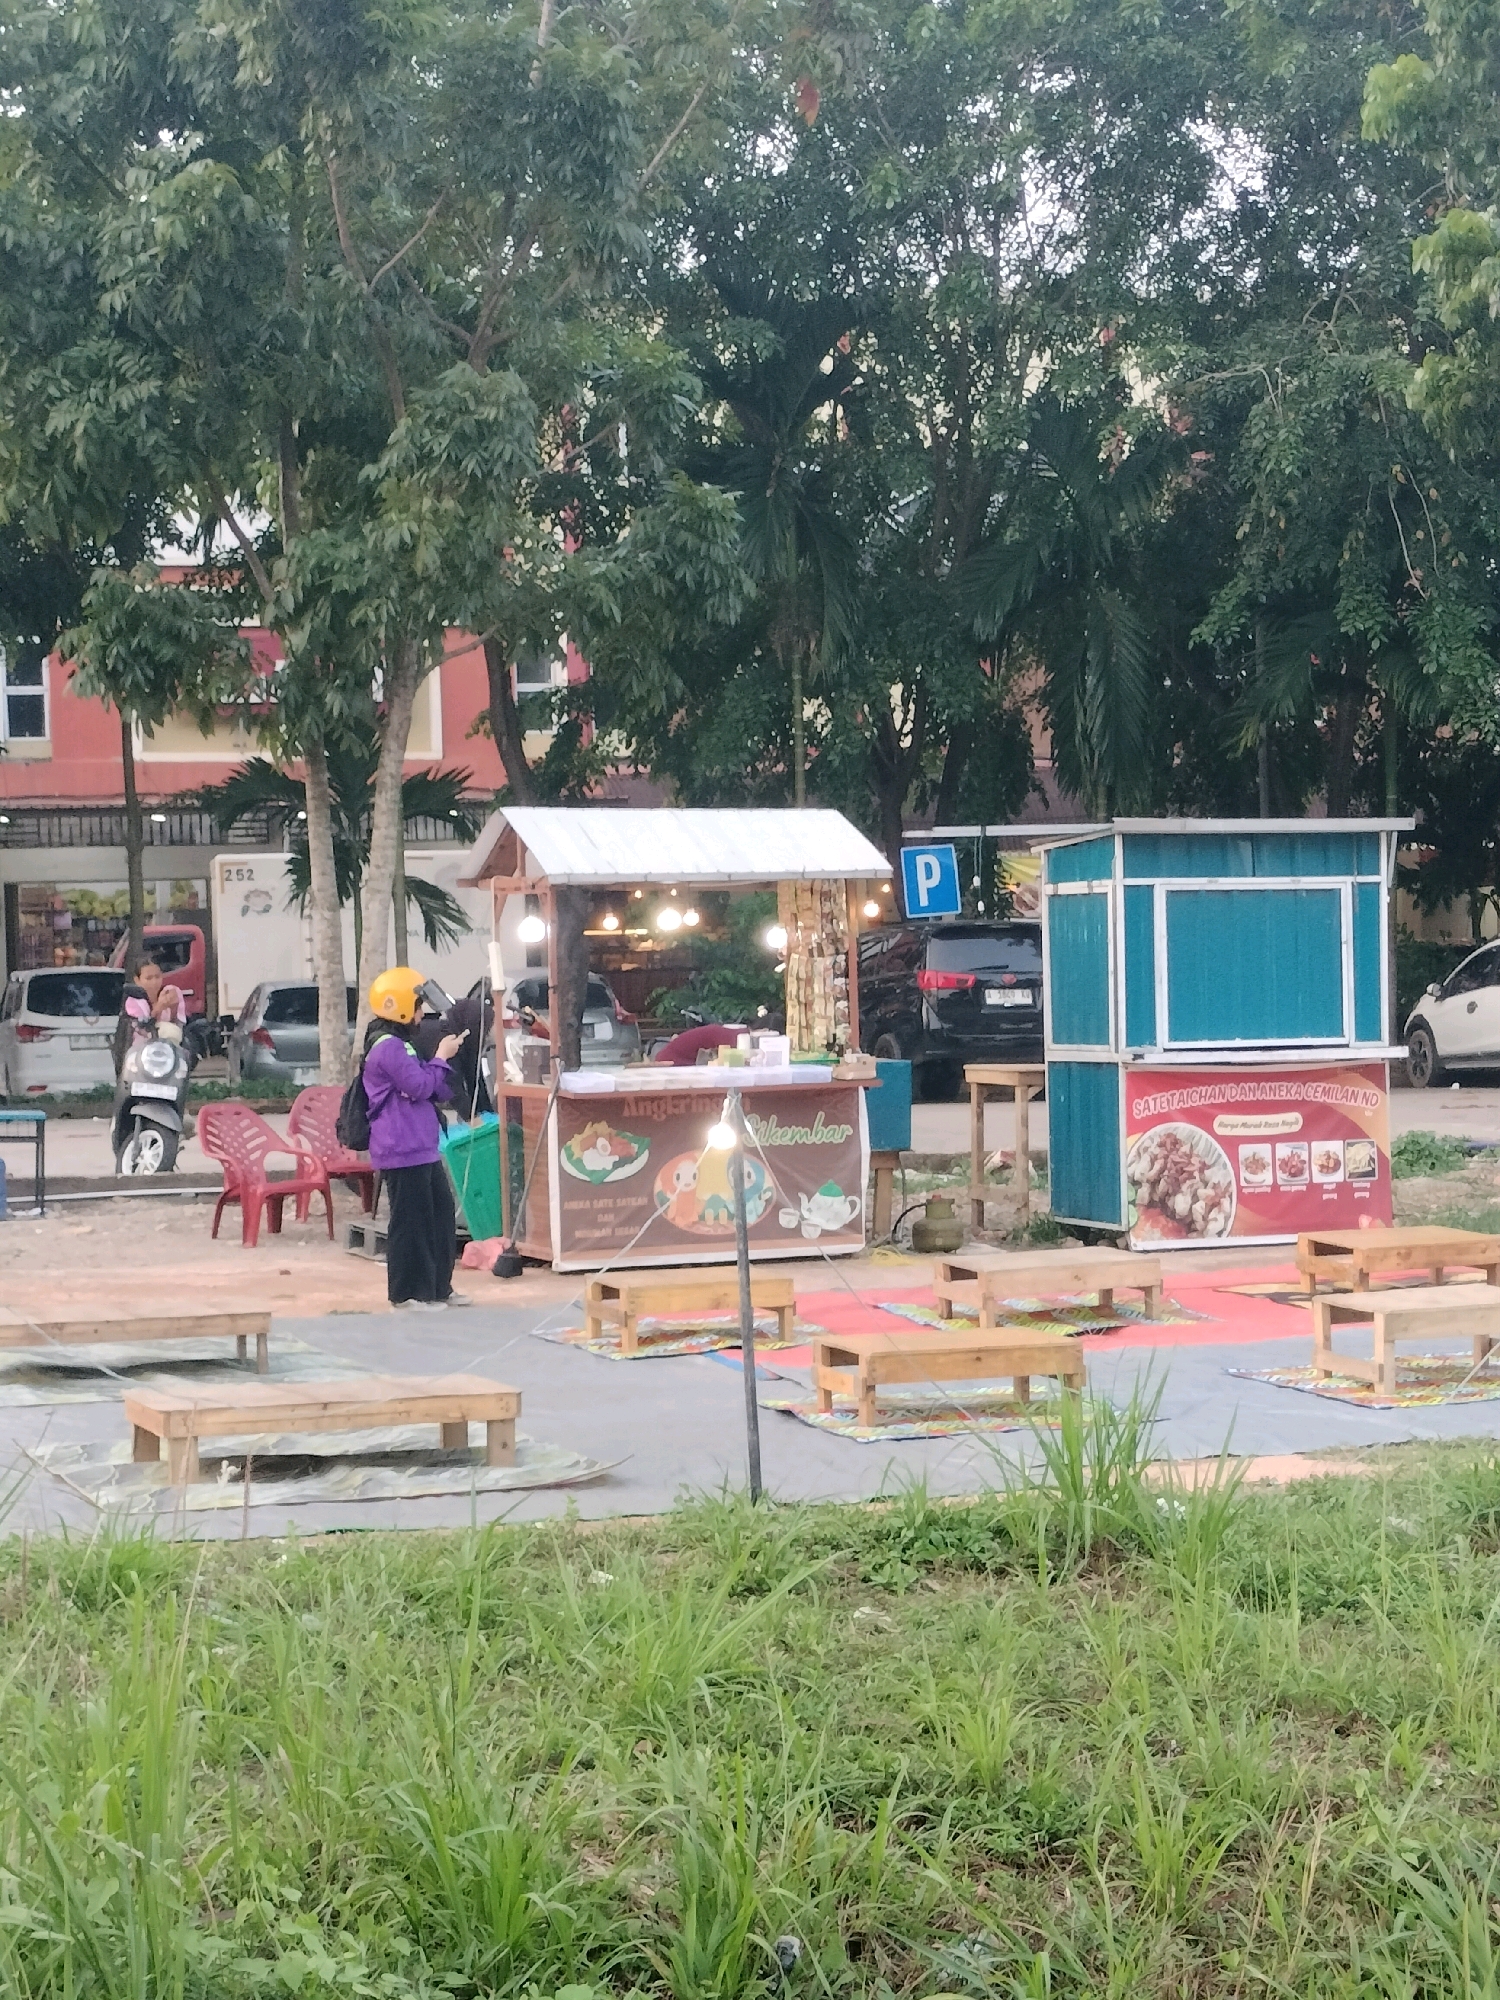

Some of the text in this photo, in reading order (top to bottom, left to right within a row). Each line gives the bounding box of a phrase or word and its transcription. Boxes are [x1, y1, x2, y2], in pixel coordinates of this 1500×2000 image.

[225, 869, 255, 881] 252
[915, 854, 941, 907] P
[1133, 1082, 1380, 1118] SATE TAICHAN DAN ANEKA CEMILAN ND
[743, 1111, 853, 1147] Sikembar
